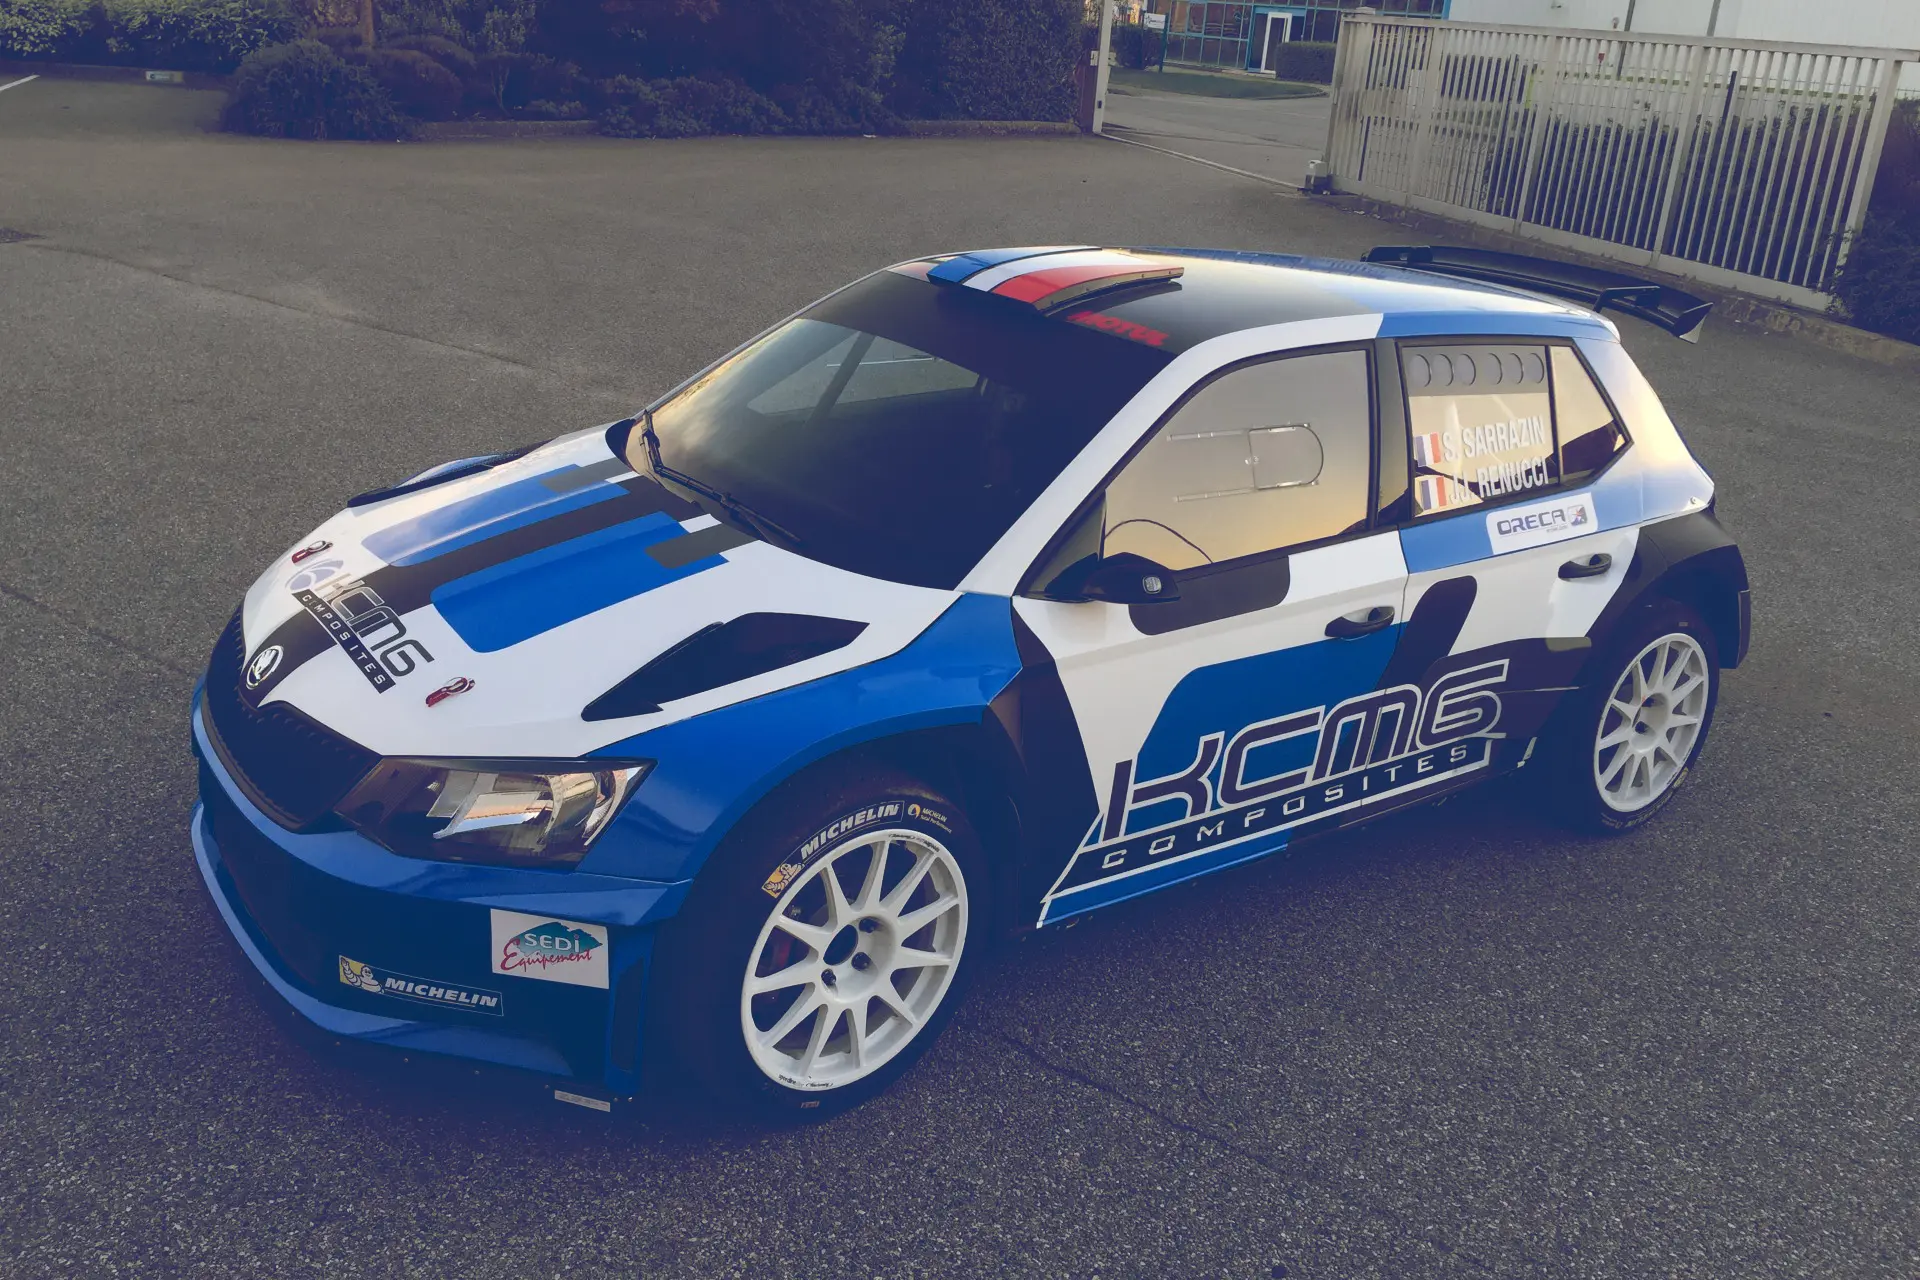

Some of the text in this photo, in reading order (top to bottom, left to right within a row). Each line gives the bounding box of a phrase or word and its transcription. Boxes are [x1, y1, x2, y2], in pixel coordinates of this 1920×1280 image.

[1464, 416, 1545, 458] SARRAZIN
[1478, 457, 1550, 499] RENUCCI
[1496, 508, 1567, 537] ORECA
[922, 807, 948, 823] MICHELIN
[1101, 743, 1470, 870] COMPOSITES
[801, 805, 899, 860] MICHELIN
[499, 938, 593, 973] Equipement
[384, 977, 499, 1008] MICHELIN
